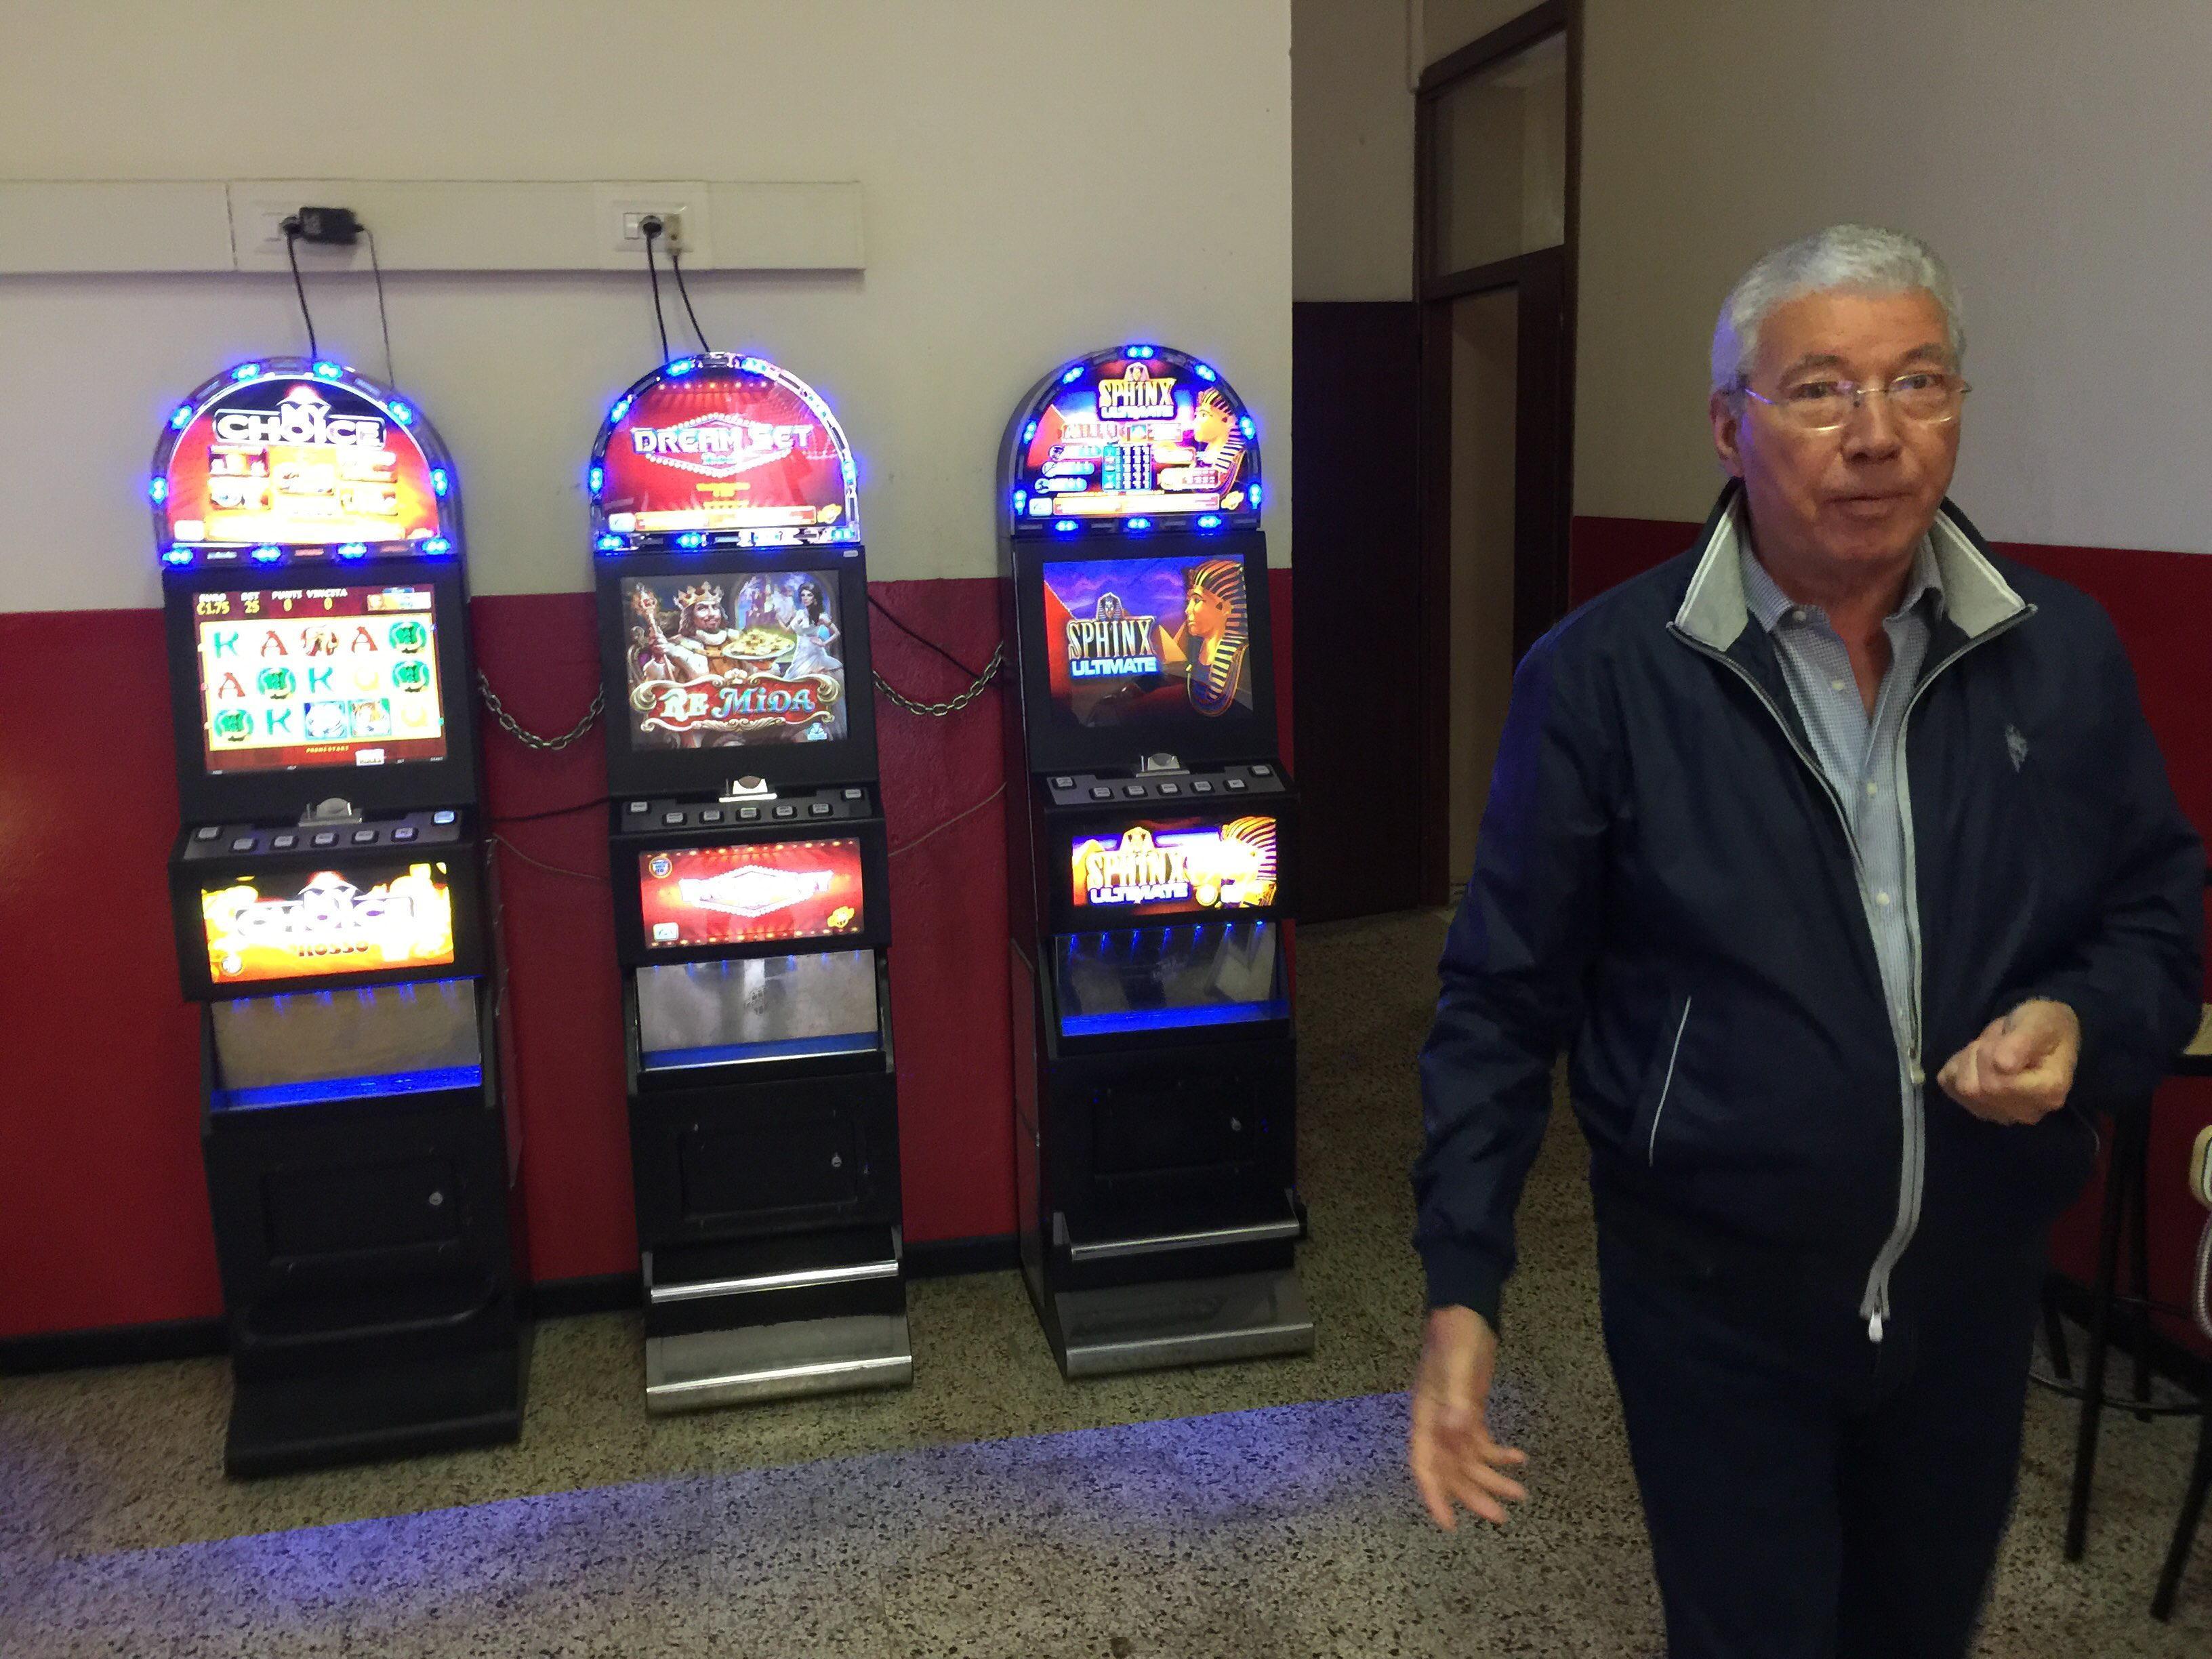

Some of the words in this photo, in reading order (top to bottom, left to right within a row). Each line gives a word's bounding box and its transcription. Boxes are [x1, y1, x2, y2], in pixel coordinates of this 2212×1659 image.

[1099, 378, 1177, 407] SPHINX
[218, 414, 381, 447] CHOICE
[632, 427, 743, 454] DREAM
[748, 424, 814, 451] SET
[244, 600, 260, 614] 25
[283, 598, 293, 612] 0
[323, 597, 333, 611] 0
[213, 632, 239, 658] K
[260, 630, 288, 657] A
[351, 626, 378, 653] A
[1067, 617, 1155, 660] SPHINX
[1071, 657, 1158, 676] ULTIMATE
[218, 672, 246, 699] A
[308, 667, 334, 693] K
[266, 708, 292, 735] K
[1085, 849, 1189, 888] SPHINX
[1090, 883, 1189, 903] ULTIMATE
